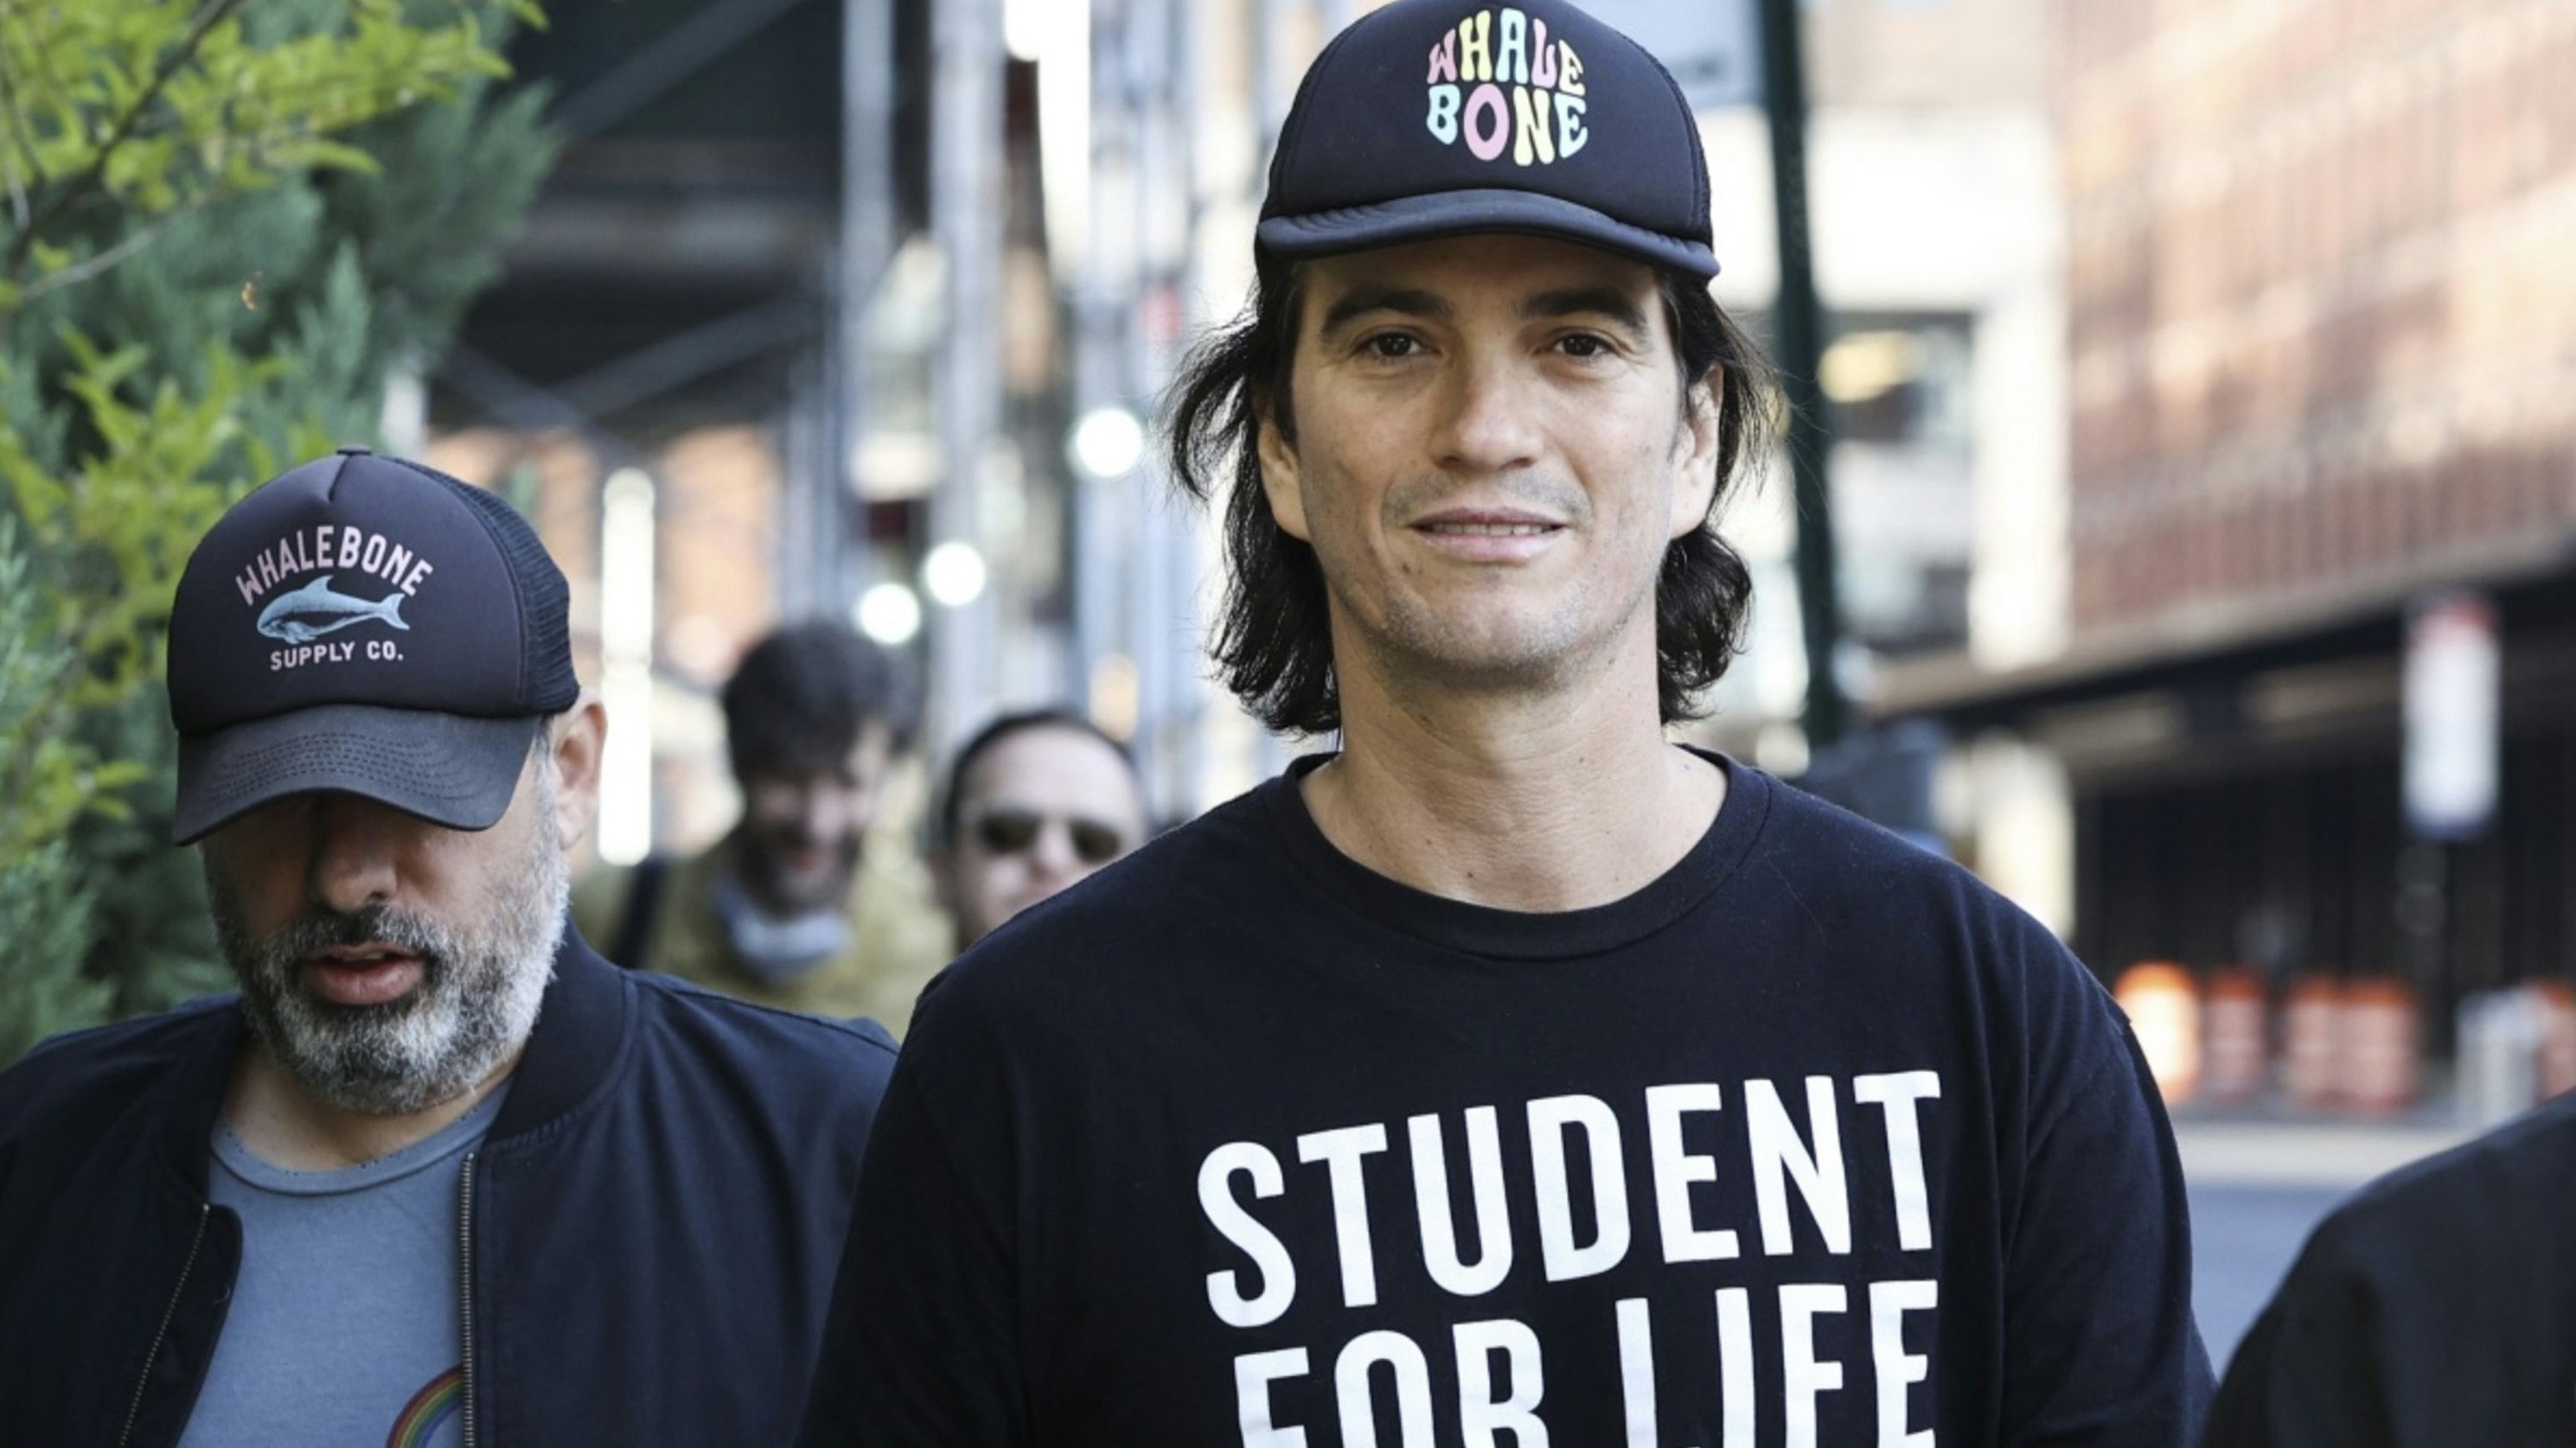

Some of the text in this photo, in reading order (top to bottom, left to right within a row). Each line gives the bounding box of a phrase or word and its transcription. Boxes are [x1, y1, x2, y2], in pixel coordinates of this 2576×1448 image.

[1427, 8, 1586, 96] WHALE
[1426, 83, 1588, 167] BONE
[235, 526, 433, 606] WHALEBONE
[270, 641, 404, 671] SUPPLY CO.
[1198, 1070, 1940, 1328] STUDENT
[1234, 1279, 1939, 1448] FOR LIFE
